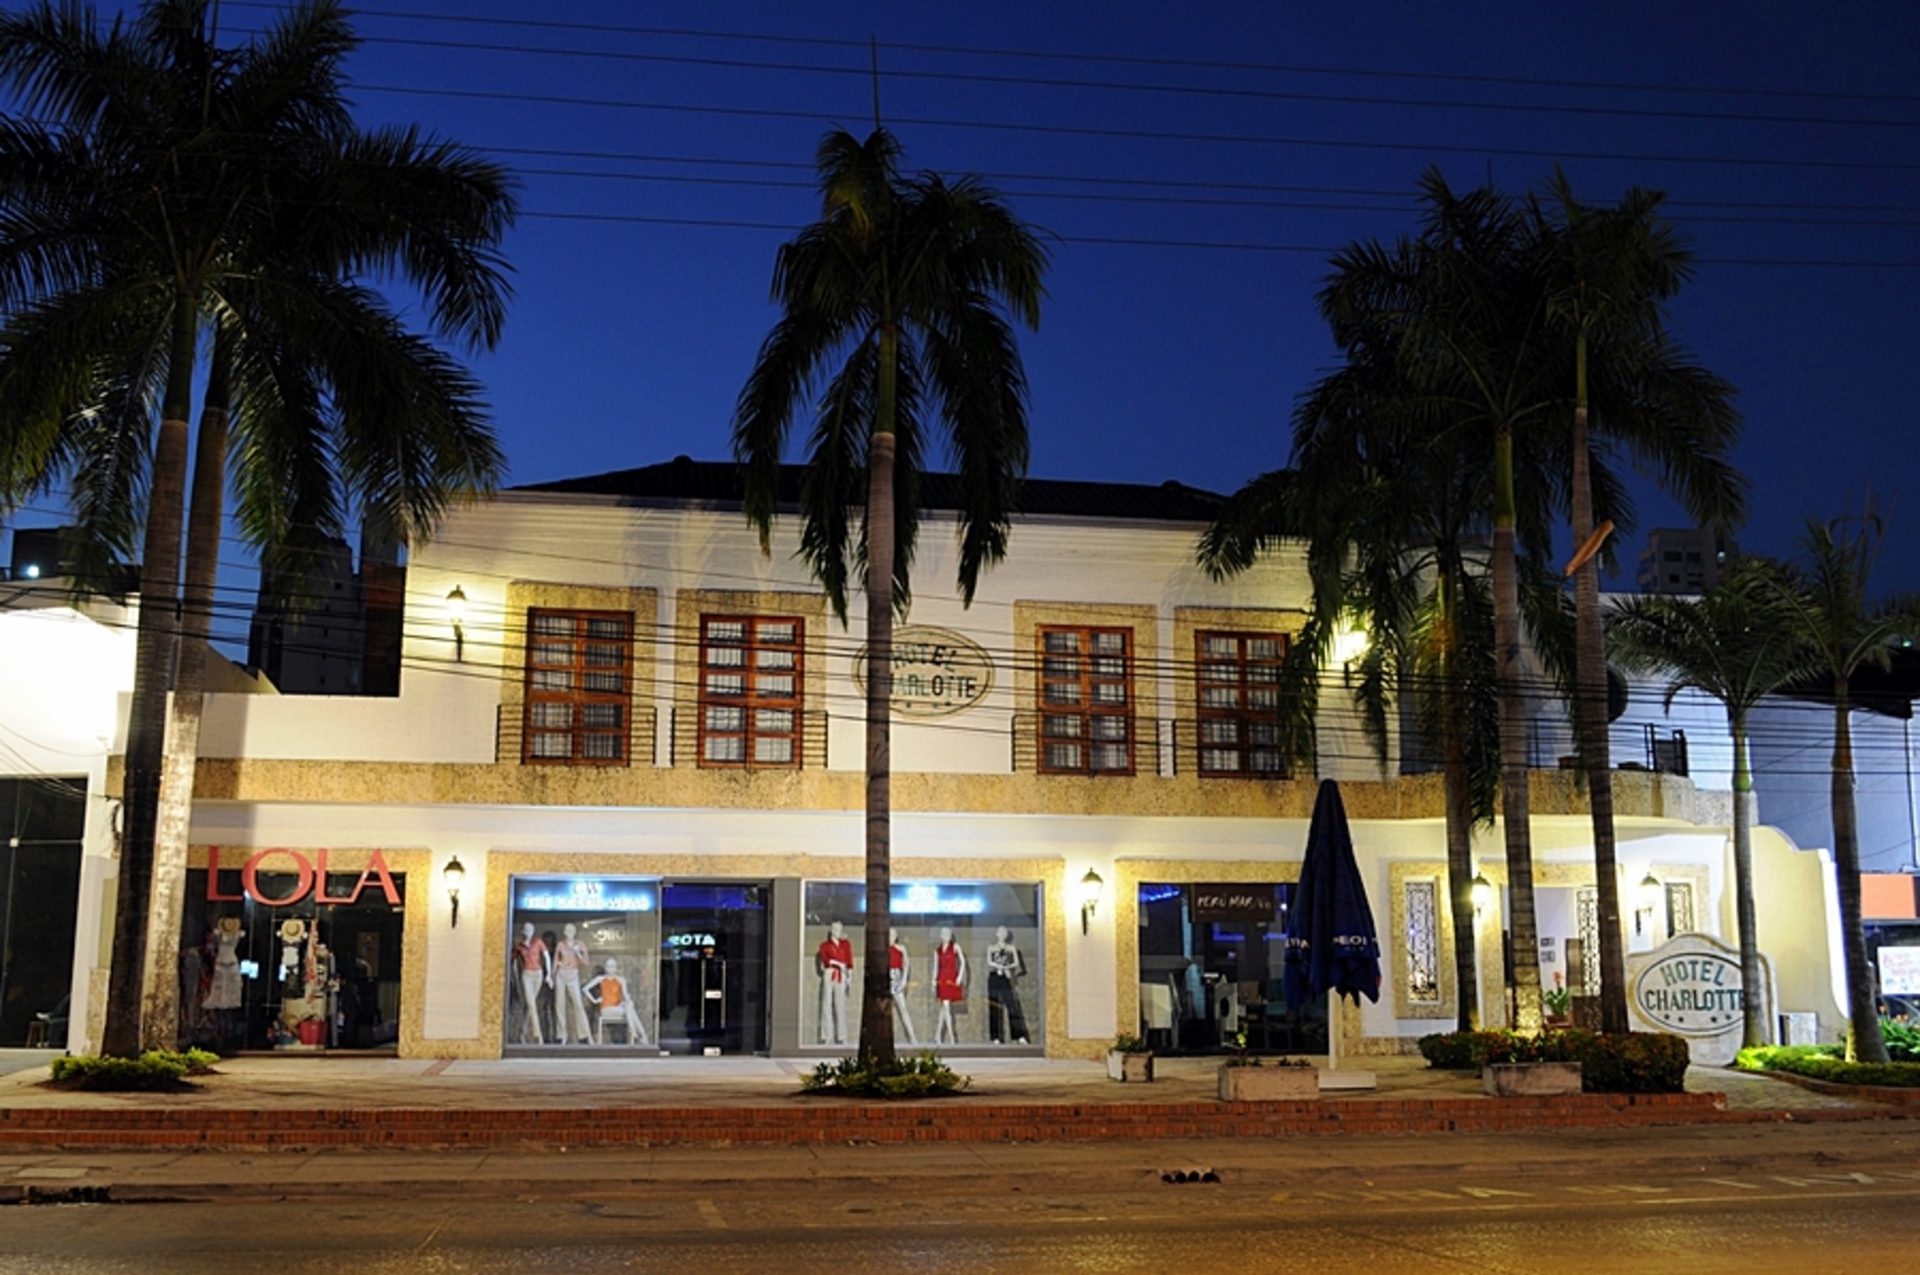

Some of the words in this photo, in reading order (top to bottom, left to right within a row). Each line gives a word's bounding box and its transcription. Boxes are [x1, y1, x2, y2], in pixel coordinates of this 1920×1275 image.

[889, 673, 977, 698] ARLOTTE
[206, 845, 401, 906] LOLA
[1660, 959, 1725, 986] HOTEL
